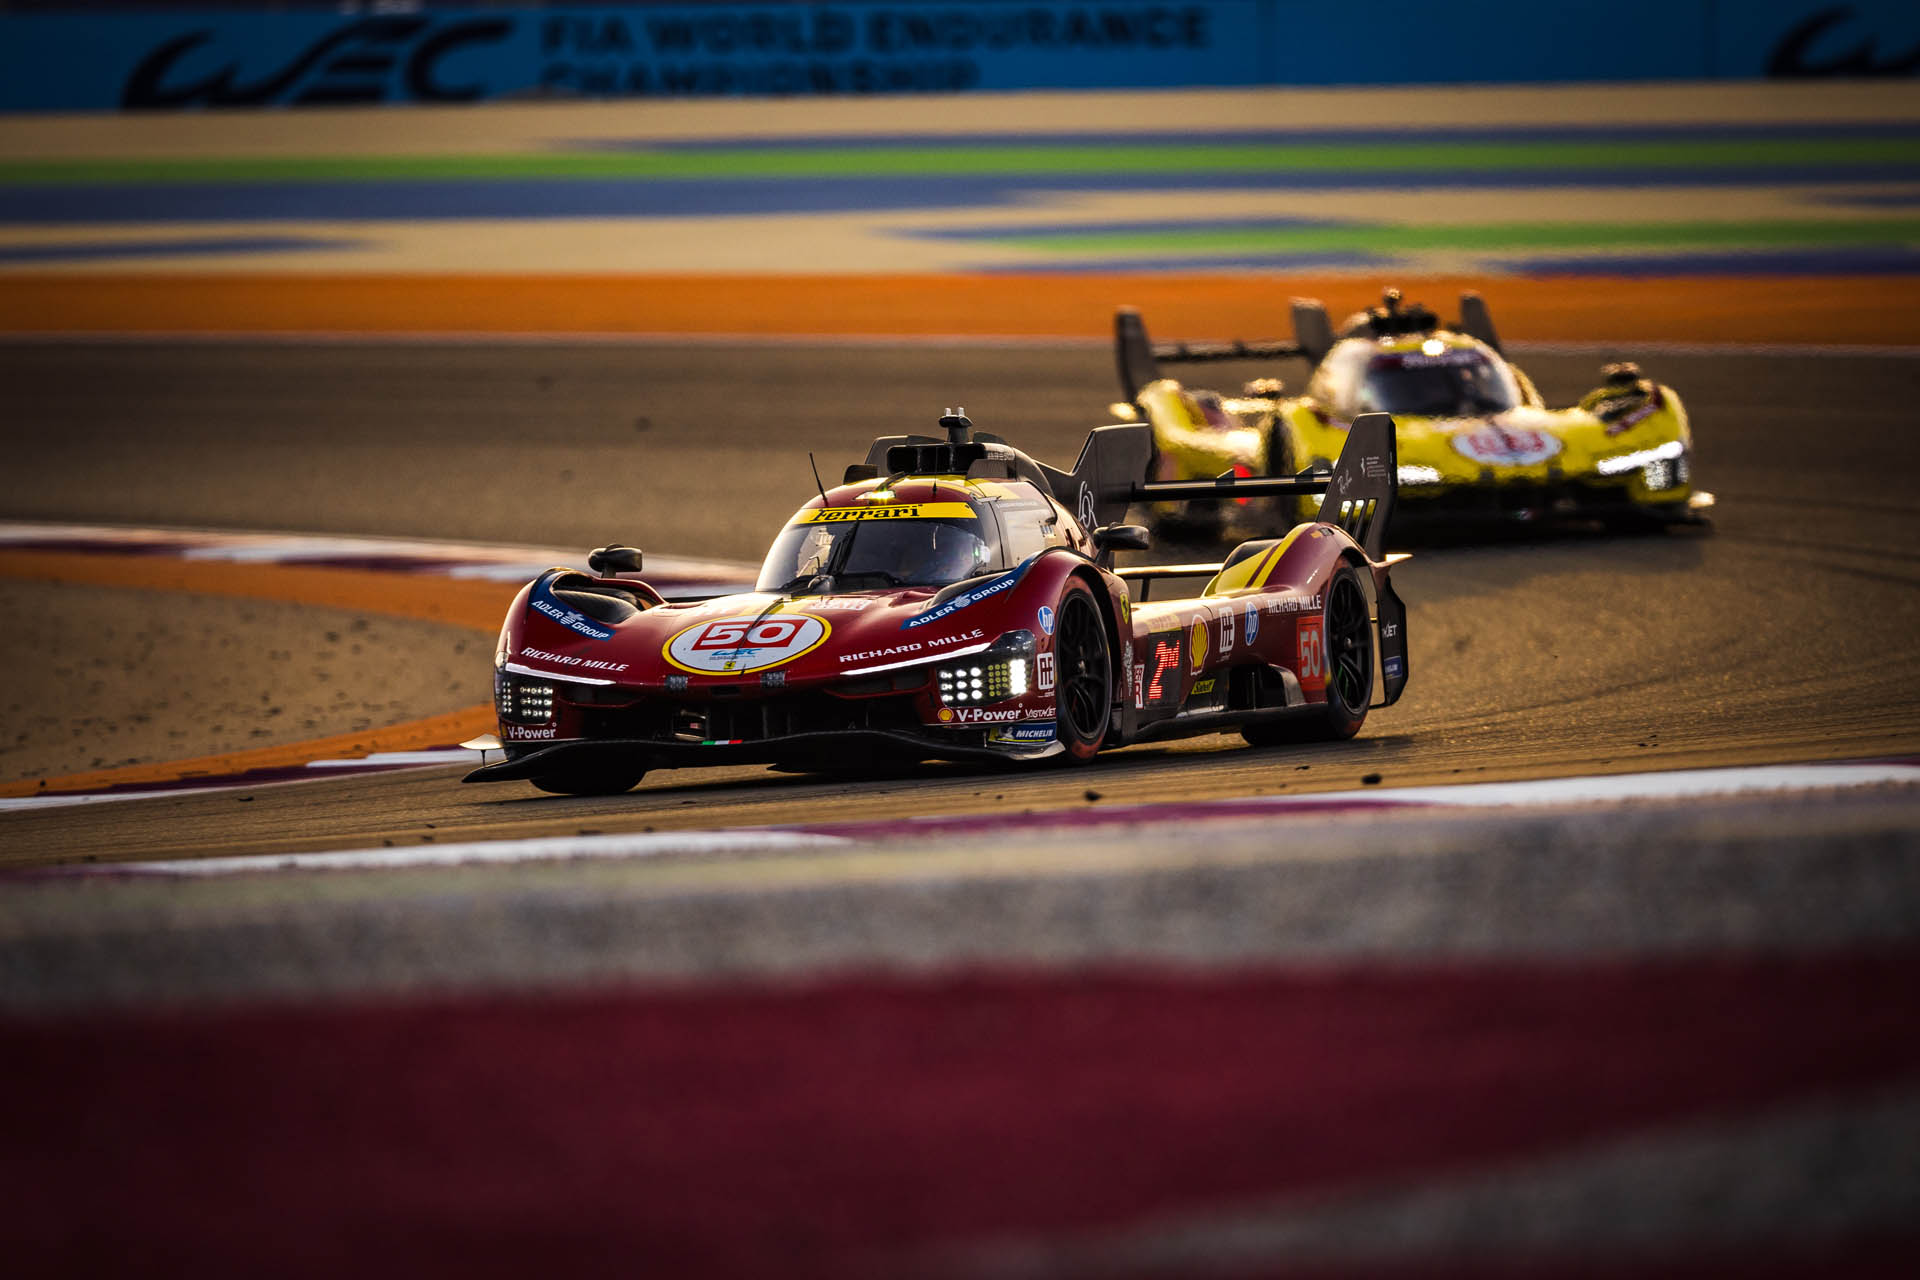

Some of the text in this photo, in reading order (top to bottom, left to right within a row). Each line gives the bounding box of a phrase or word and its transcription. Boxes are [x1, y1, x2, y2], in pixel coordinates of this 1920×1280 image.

[540, 7, 1211, 56] FIA WORLD ENDURANCE
[810, 504, 923, 522] Ferrari
[908, 578, 1016, 627] ADLER GROUP
[1267, 594, 1322, 614] RICHARD MILLE
[531, 600, 610, 640] ADLER GROUP
[1039, 606, 1054, 635] hp
[1246, 603, 1258, 644] hp
[700, 622, 796, 646] 50
[838, 628, 985, 664] RICHARD MILLE
[520, 647, 630, 672] RICHARD MILLE
[1300, 629, 1321, 678] 50
[956, 708, 1022, 722] V-Power
[507, 725, 557, 739] V-Power
[1015, 728, 1054, 738] MICHELIN
